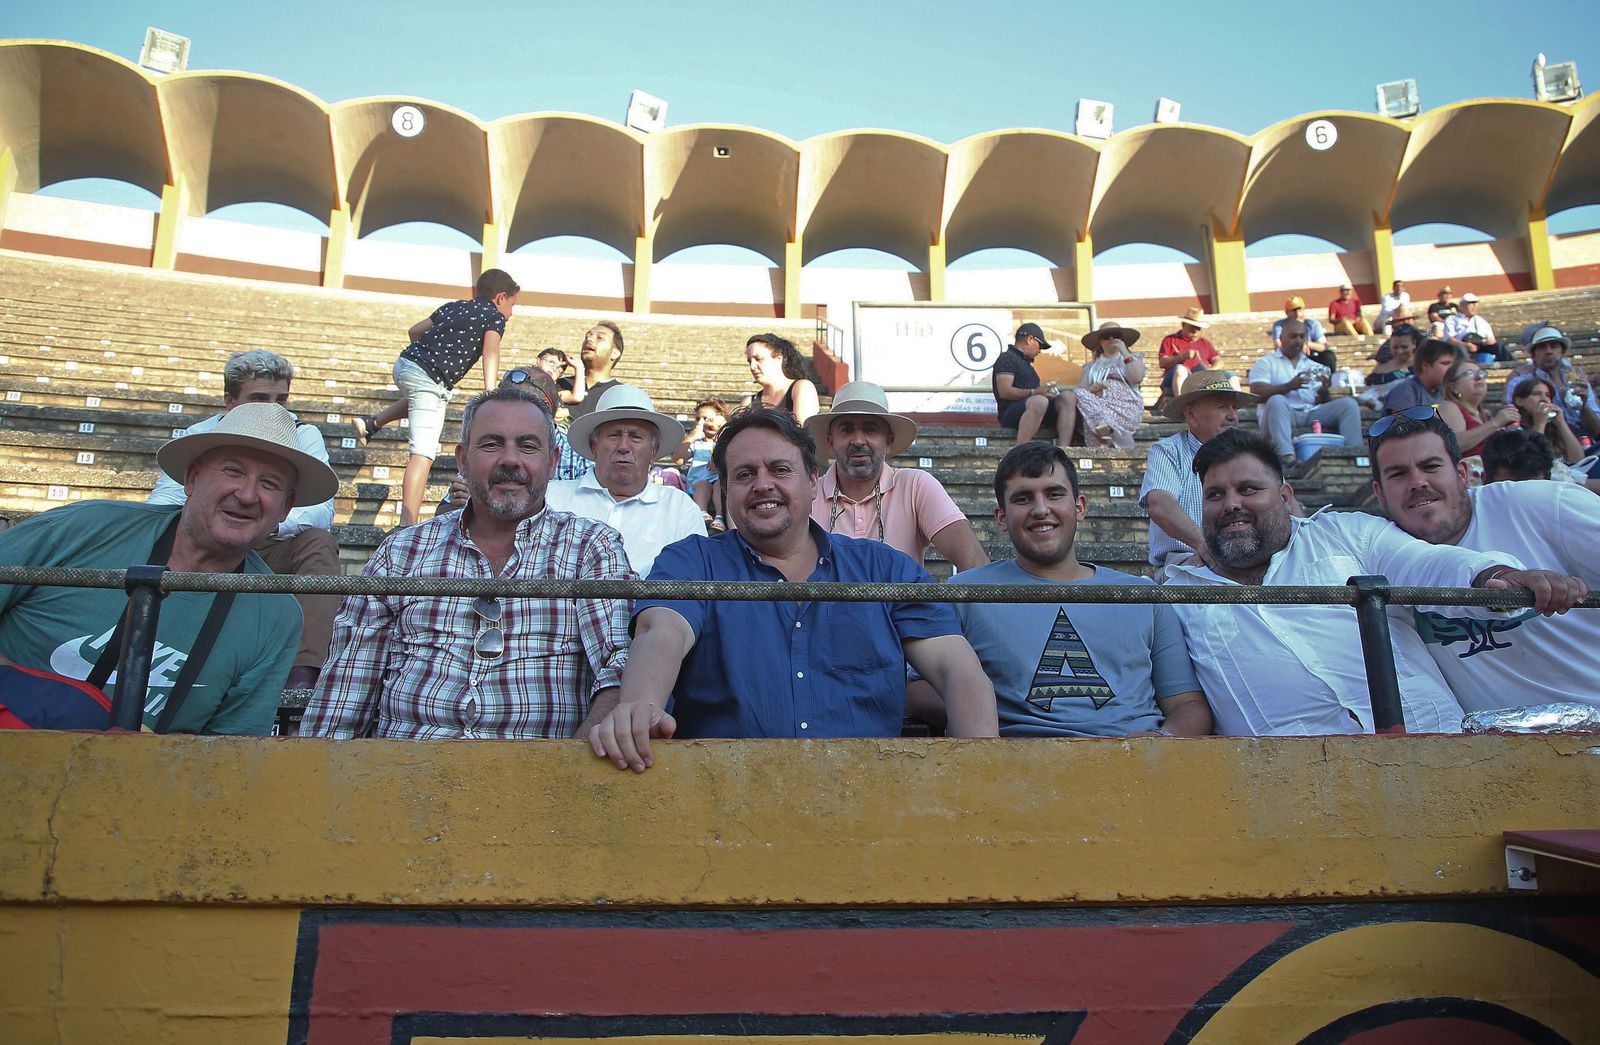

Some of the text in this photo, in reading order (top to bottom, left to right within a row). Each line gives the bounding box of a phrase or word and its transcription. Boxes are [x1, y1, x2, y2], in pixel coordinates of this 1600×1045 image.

[401, 111, 414, 131] 8
[1315, 125, 1328, 144] 6
[966, 331, 987, 363] 6
